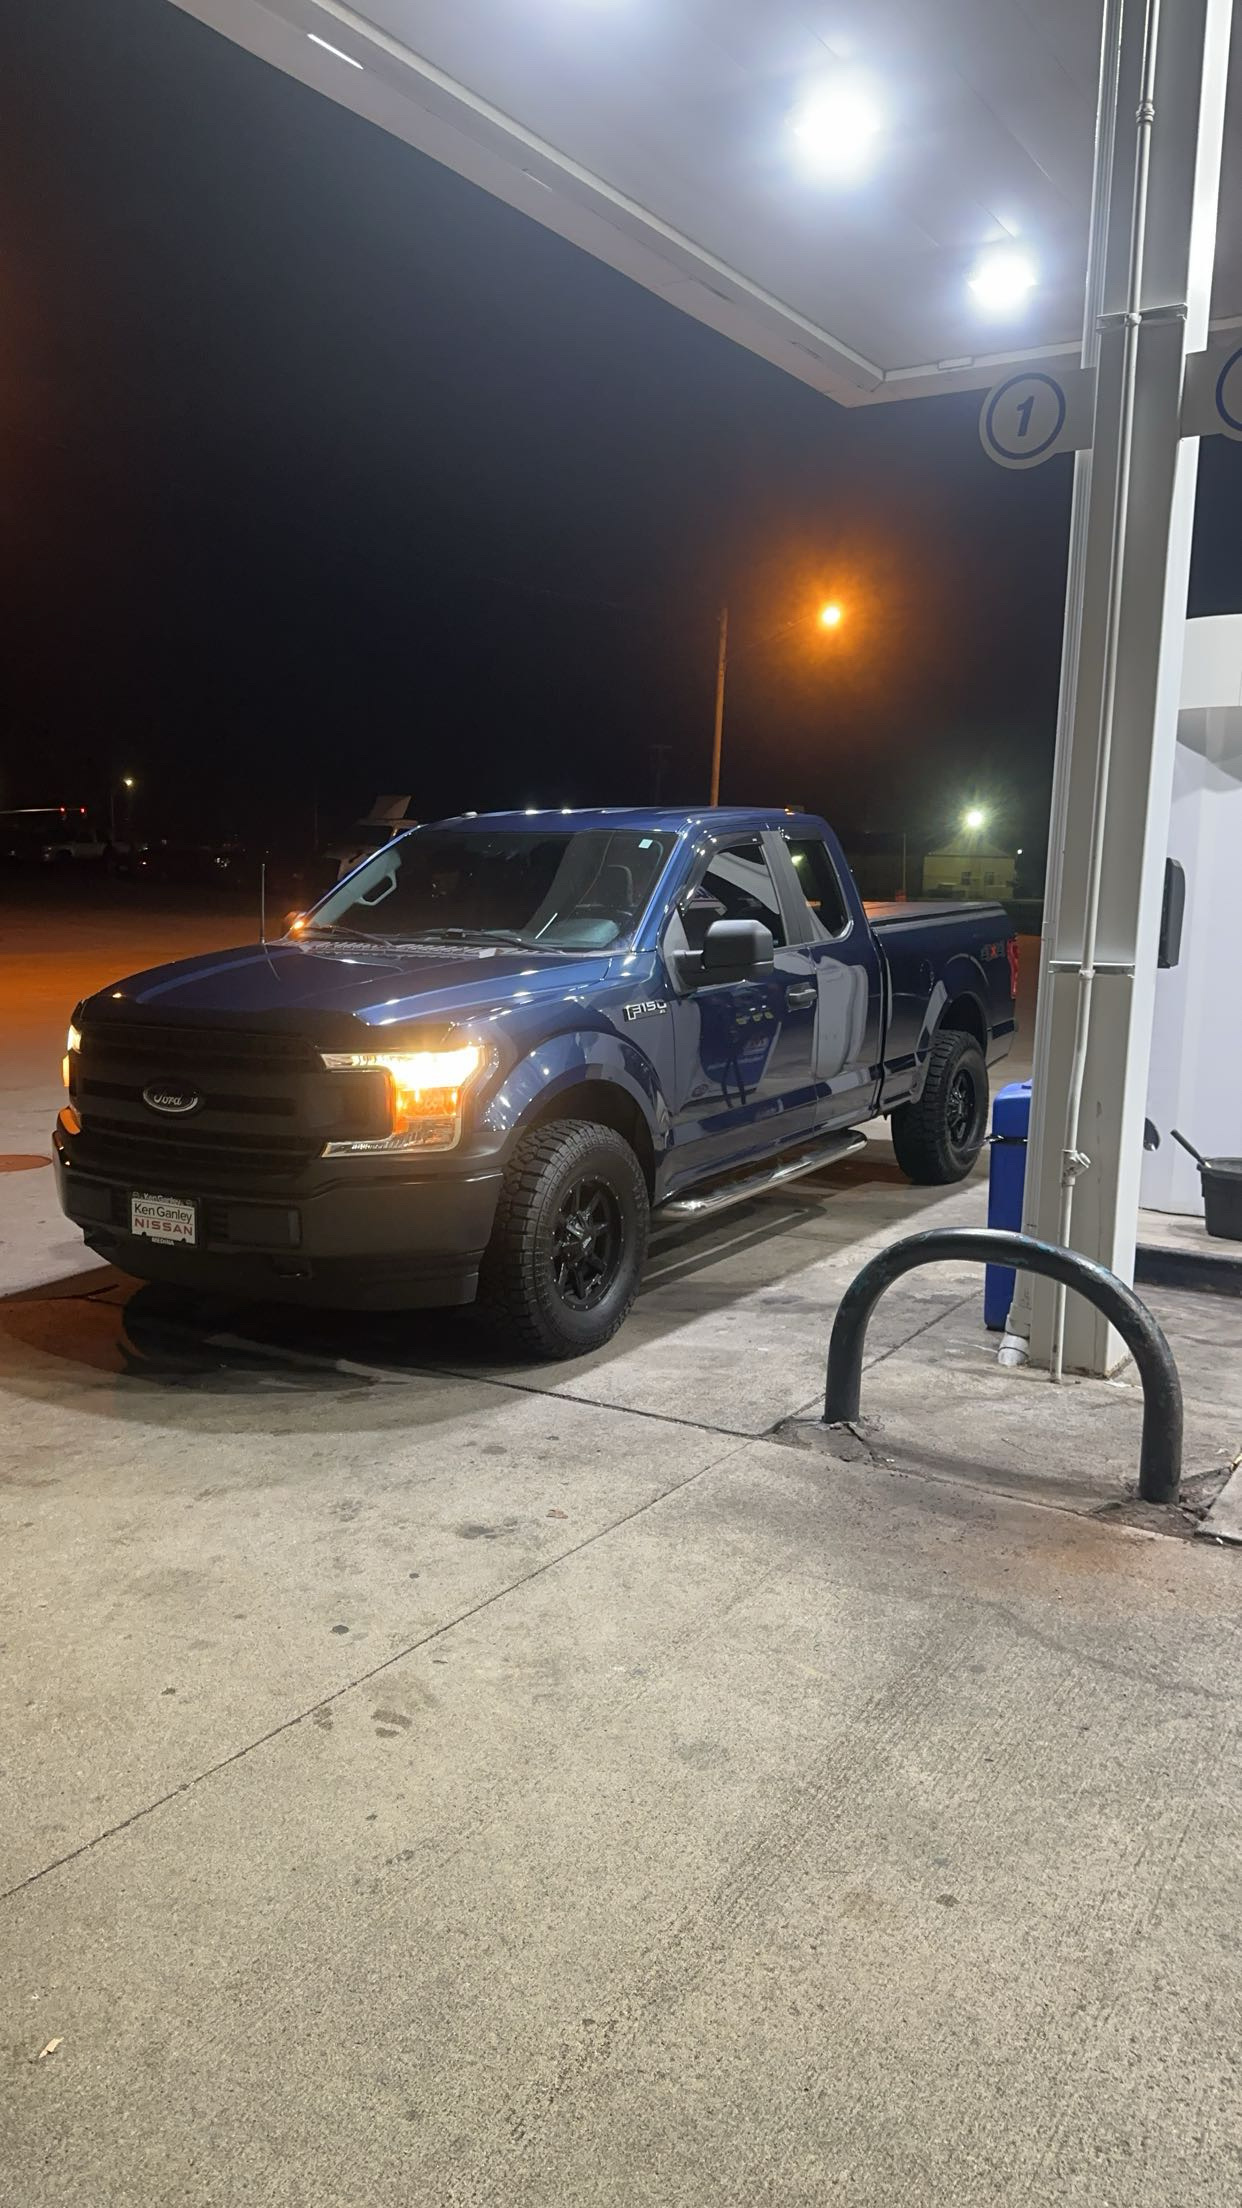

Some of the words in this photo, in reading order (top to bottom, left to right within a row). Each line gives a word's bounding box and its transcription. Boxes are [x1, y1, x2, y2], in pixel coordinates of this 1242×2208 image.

[1016, 395, 1035, 437] 1
[153, 1091, 183, 1105] Ford
[134, 1203, 155, 1216] Ken
[156, 1206, 192, 1225] Ganley
[134, 1218, 193, 1236] NISSAN
